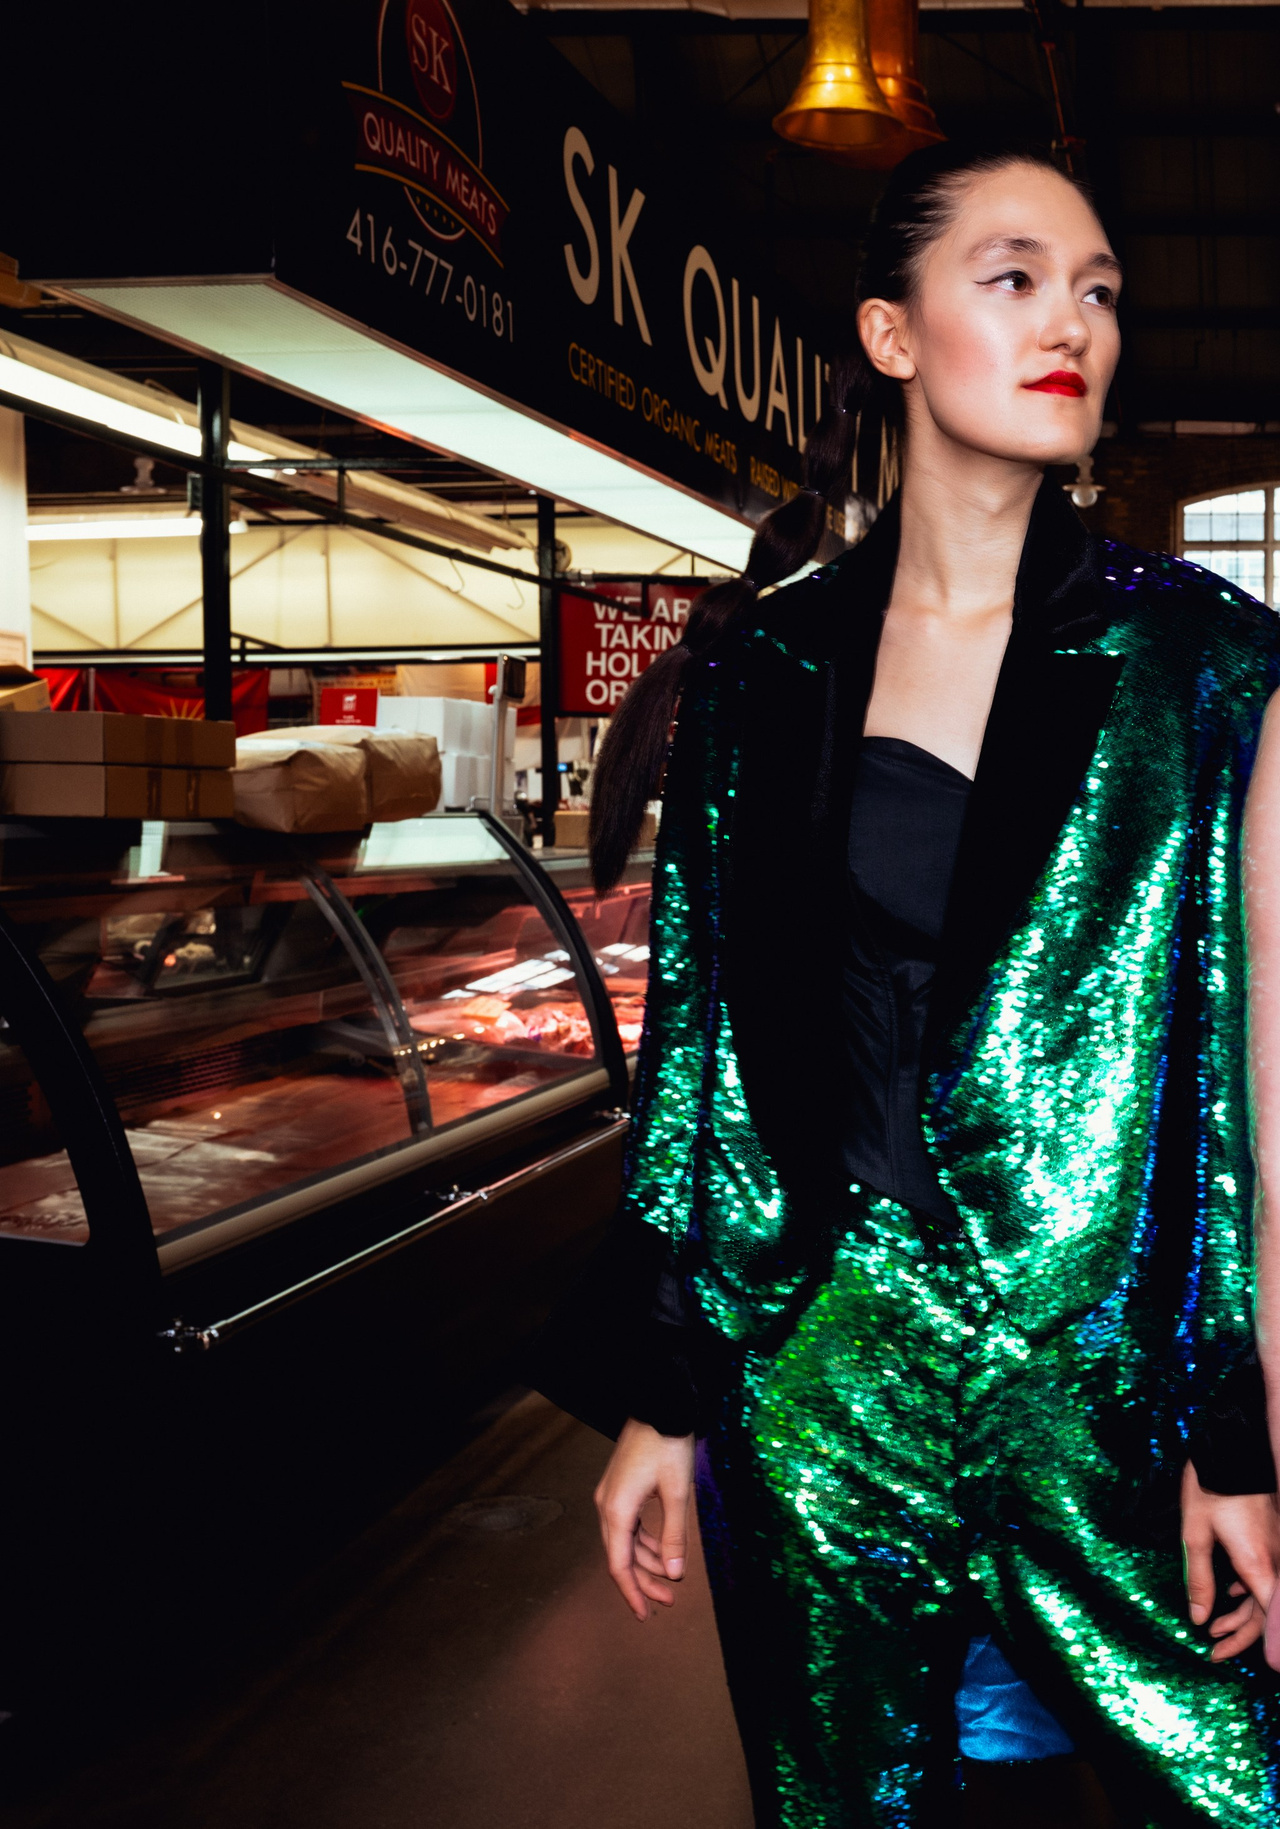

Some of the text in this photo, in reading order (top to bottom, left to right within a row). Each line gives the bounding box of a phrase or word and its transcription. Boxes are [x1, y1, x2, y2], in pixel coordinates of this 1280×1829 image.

[412, 13, 452, 95] SK
[363, 111, 498, 236] QUALITY MEATS
[345, 206, 514, 344] 416-777-0181
[563, 126, 653, 347] SK
[567, 341, 637, 413] CERTIFIED
[640, 386, 702, 453] ORGANIC
[704, 429, 739, 475] MEATS
[585, 650, 656, 679] HOL
[593, 596, 643, 623] WE
